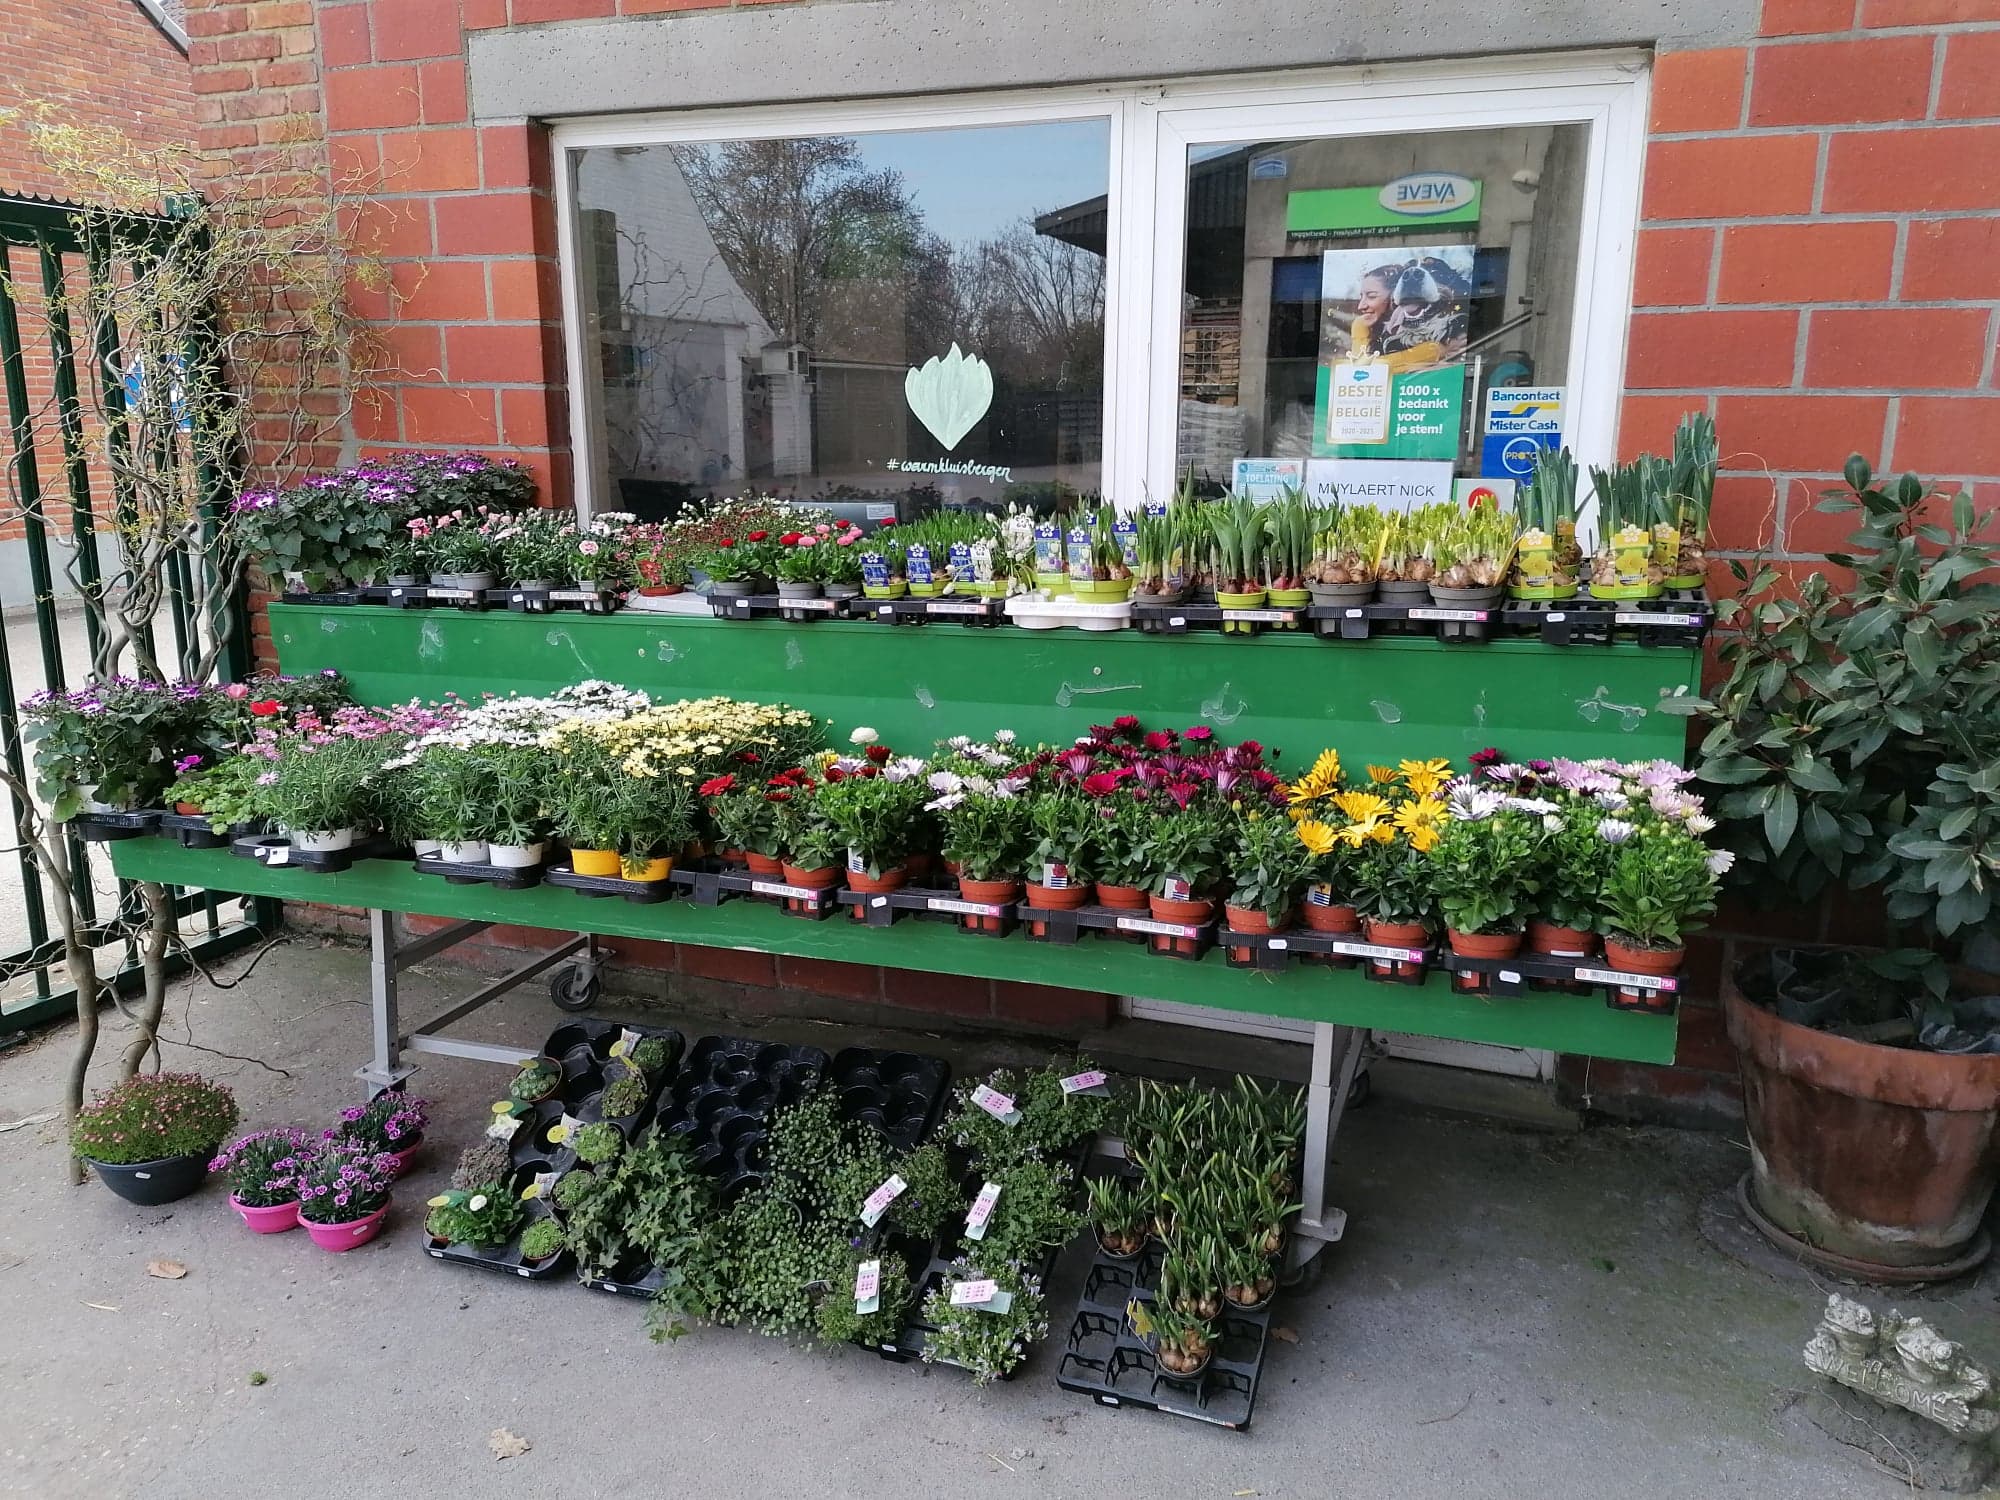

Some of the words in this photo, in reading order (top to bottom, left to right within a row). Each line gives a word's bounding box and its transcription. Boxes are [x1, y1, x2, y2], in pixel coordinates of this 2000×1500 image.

[1338, 385, 1383, 397] BESTE
[1399, 385, 1430, 396] 1000
[1433, 387, 1440, 396] x
[1492, 391, 1560, 401] Bancontact
[1398, 398, 1449, 409] bedankt
[1336, 405, 1381, 418] BELGIË
[1397, 412, 1426, 421] voor
[1394, 423, 1408, 437] je
[1409, 424, 1443, 435] stem!
[1490, 421, 1526, 431] Mister
[1528, 420, 1558, 431] Cash
[1318, 482, 1396, 496] MUYLAERT
[1400, 484, 1436, 497] NICK
